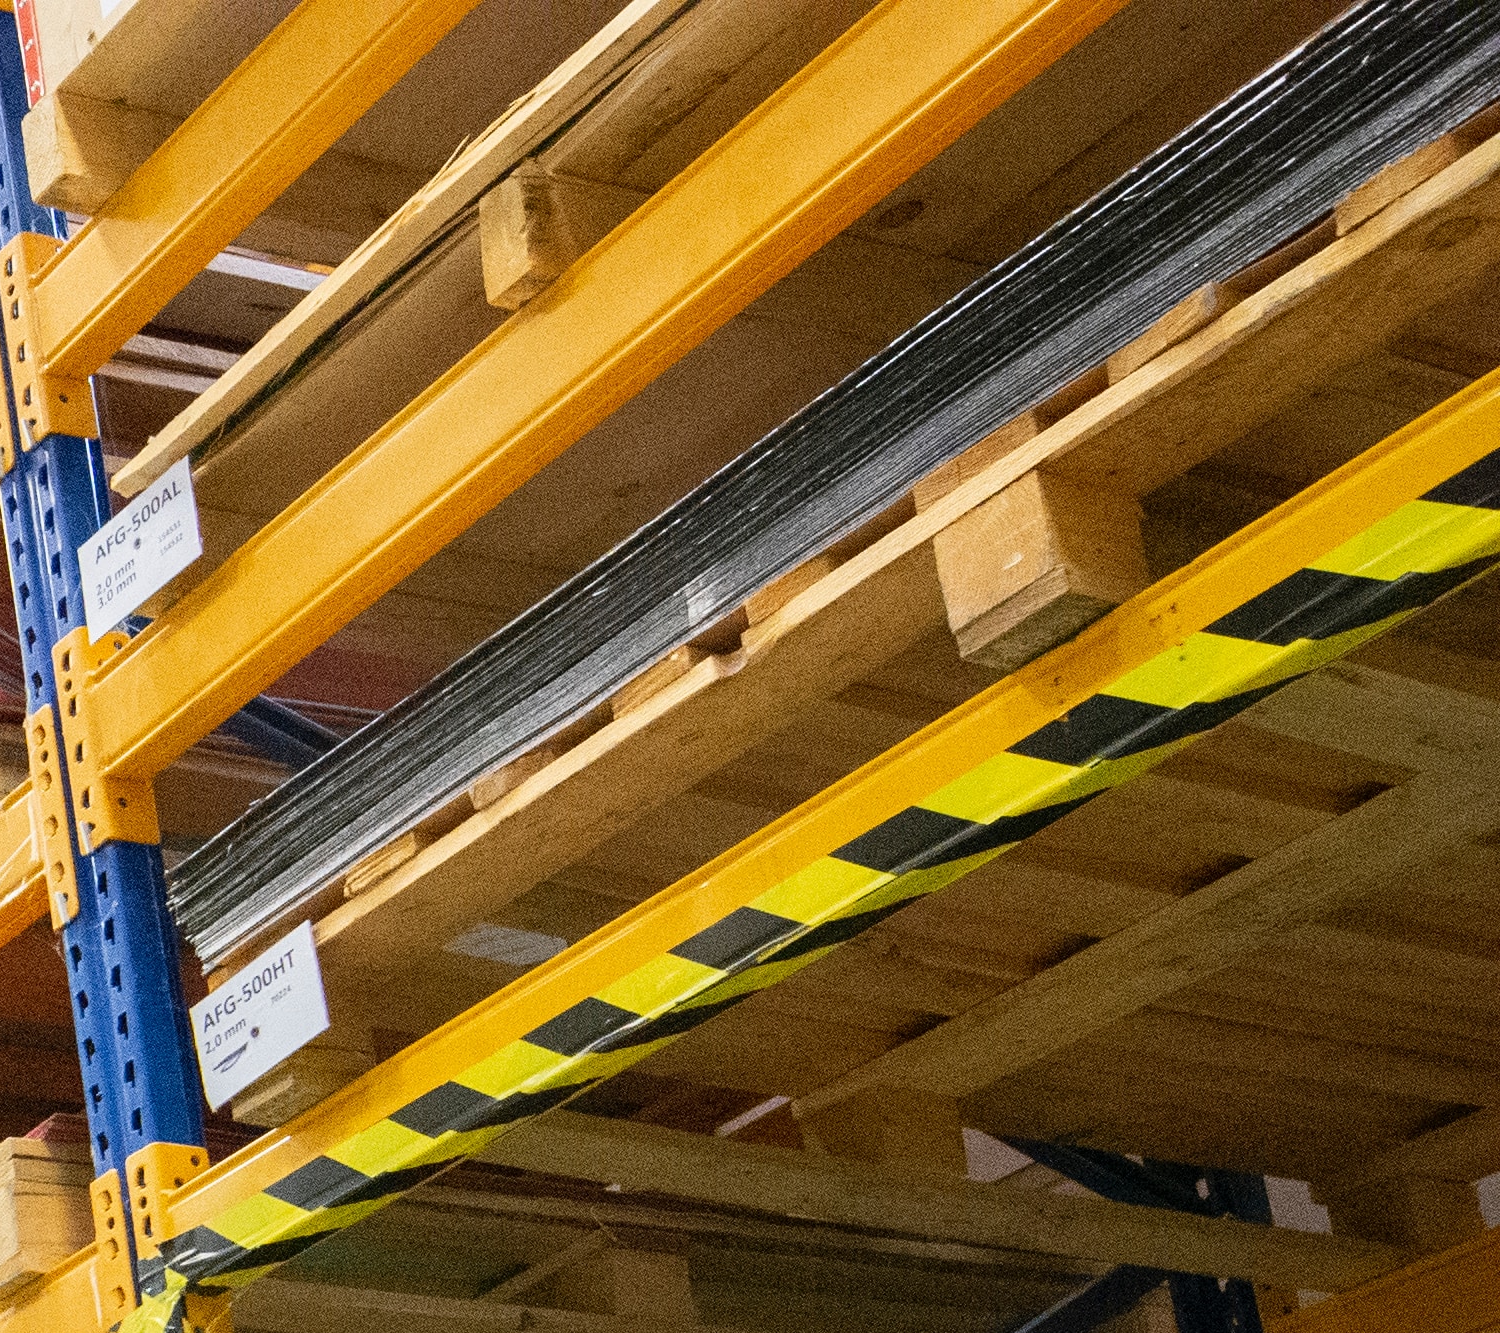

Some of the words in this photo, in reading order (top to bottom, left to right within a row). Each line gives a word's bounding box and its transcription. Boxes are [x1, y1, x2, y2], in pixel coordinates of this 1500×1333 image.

[94, 477, 181, 564] AFG-500AL
[114, 556, 135, 581] mm
[116, 569, 136, 594] mm
[201, 948, 297, 1033] AFG-500HT
[223, 1015, 246, 1040] mm
